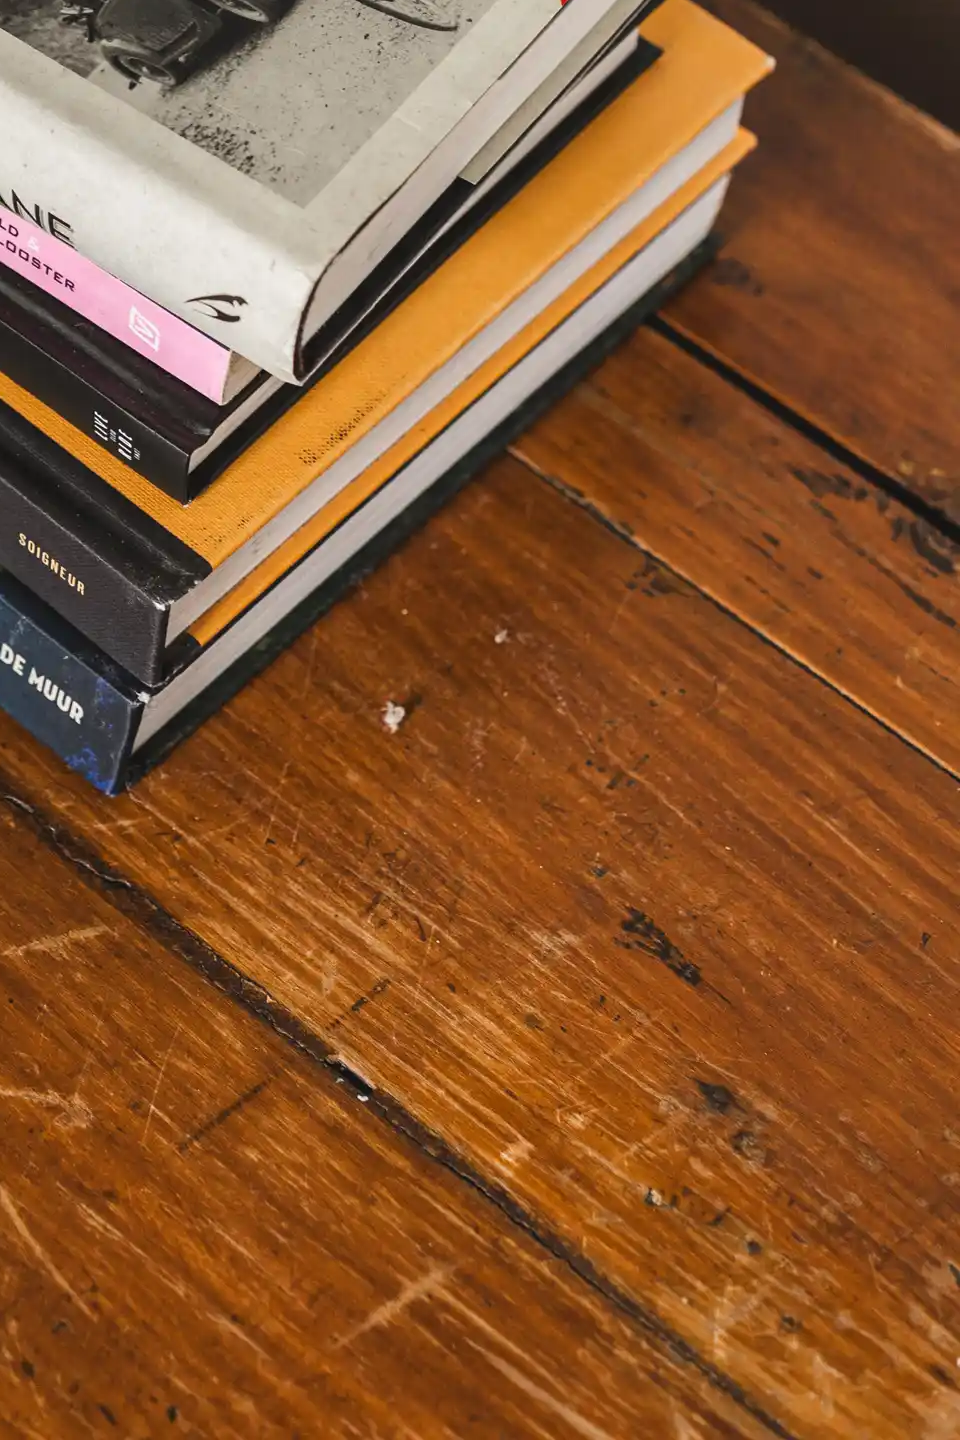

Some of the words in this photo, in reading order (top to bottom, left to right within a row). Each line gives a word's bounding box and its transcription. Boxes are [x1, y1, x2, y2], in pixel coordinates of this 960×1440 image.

[27, 235, 39, 252] &
[18, 532, 85, 596] SOIGNEUR
[28, 667, 85, 726] MUUR
